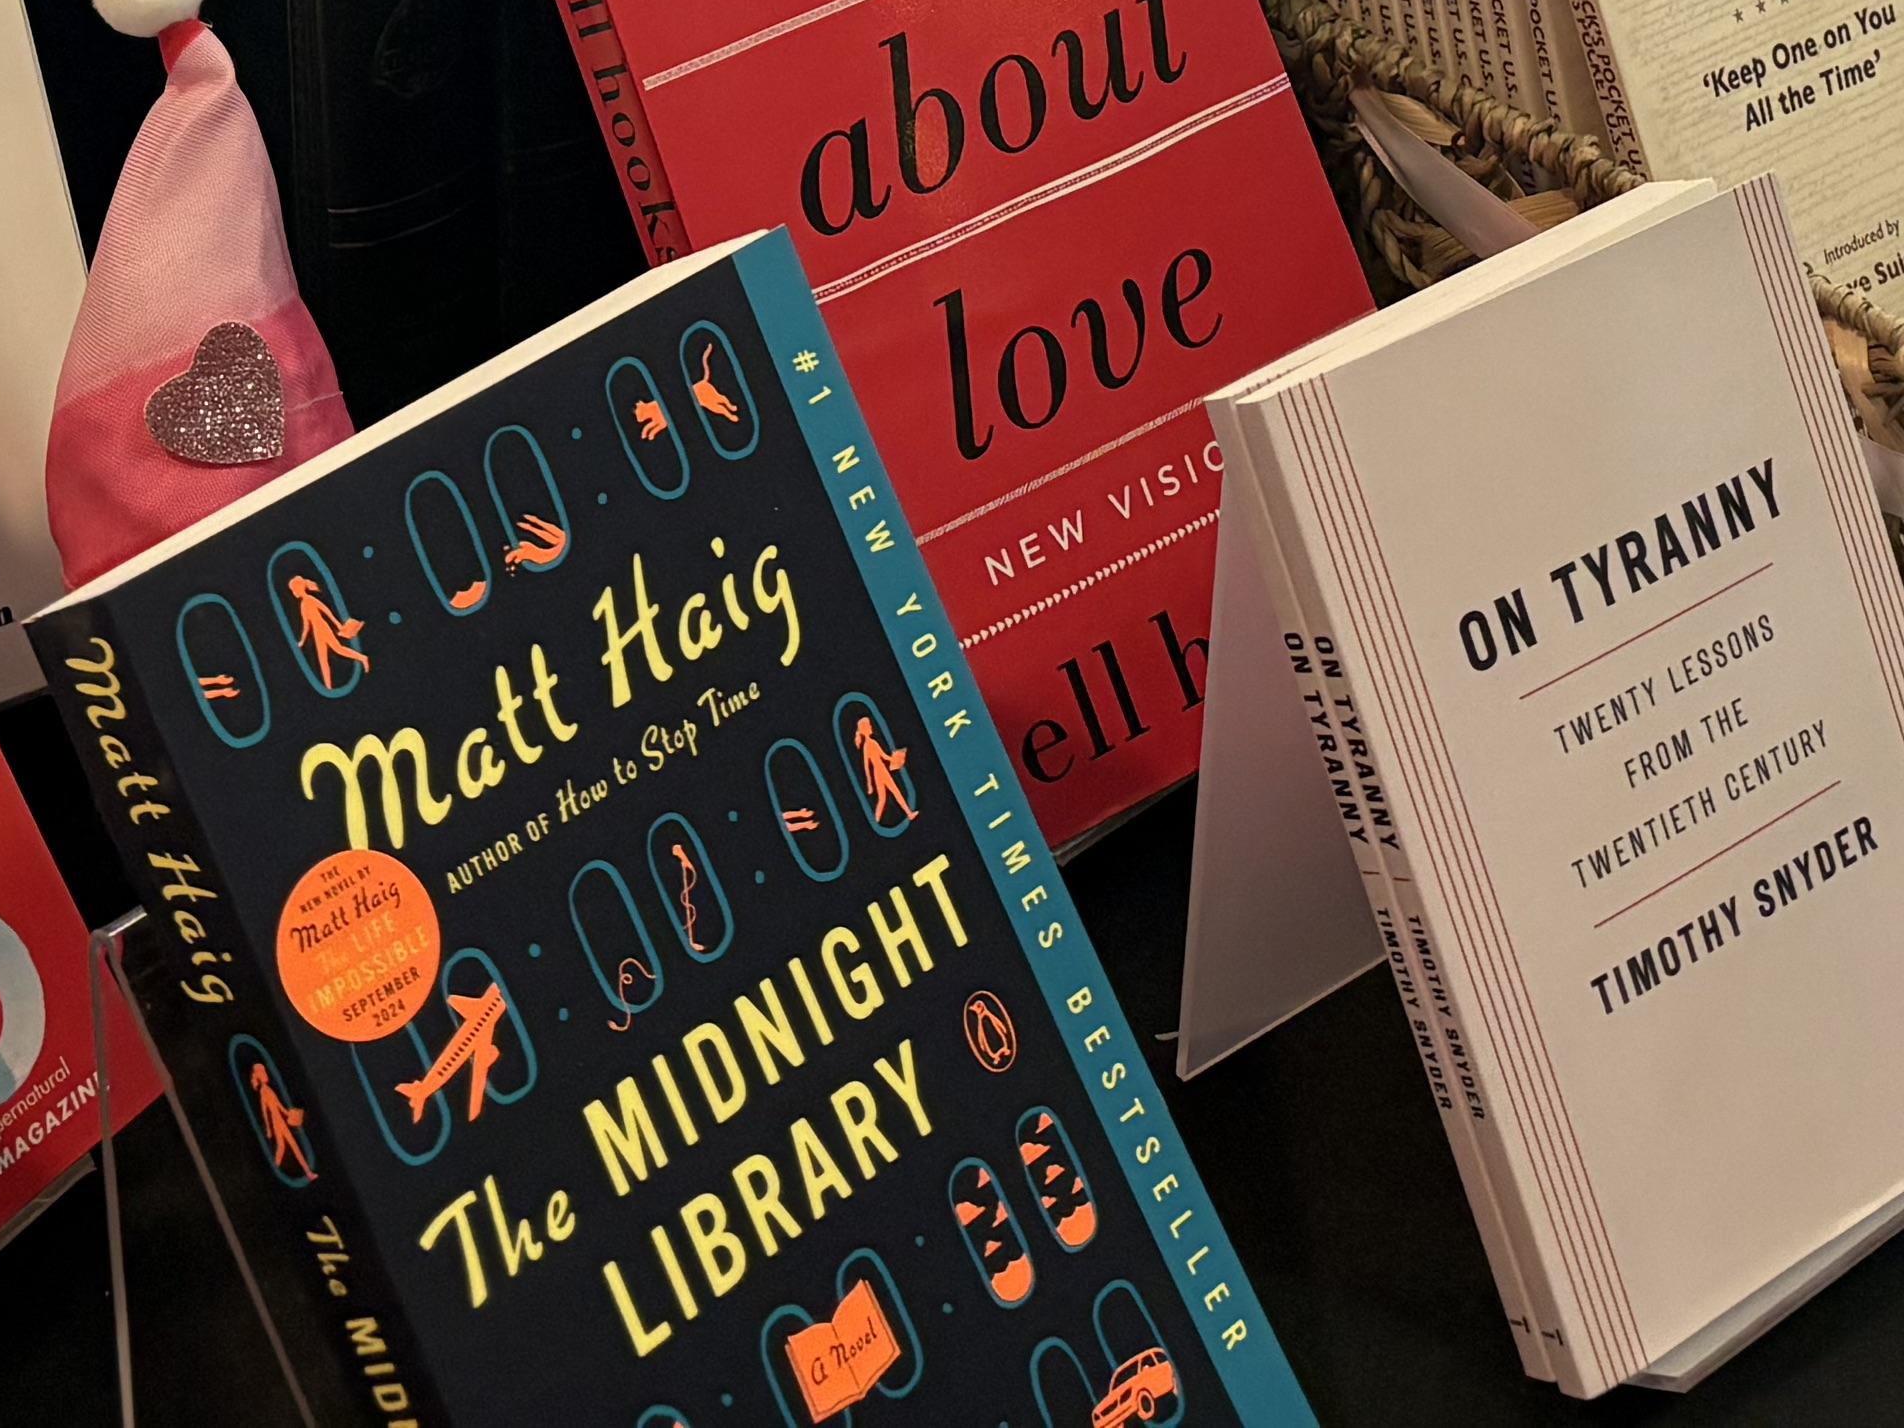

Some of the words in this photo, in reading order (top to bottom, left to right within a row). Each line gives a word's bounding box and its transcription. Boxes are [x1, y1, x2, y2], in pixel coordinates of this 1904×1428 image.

[933, 243, 1226, 463] love
[1457, 593, 1532, 675] ON
[1547, 456, 1789, 629] TYRANNY
[299, 637, 563, 853] Matt
[591, 534, 803, 711] Haig
[1554, 676, 1661, 758] TWENTY
[1666, 611, 1777, 701] LESSONS
[1588, 891, 1747, 1019] TIMOTHY
[1751, 812, 1882, 922] SNYDER
[418, 1174, 580, 1312] The
[581, 852, 973, 1199] MIDNIGHT
[600, 1037, 937, 1360] LIBRARY
